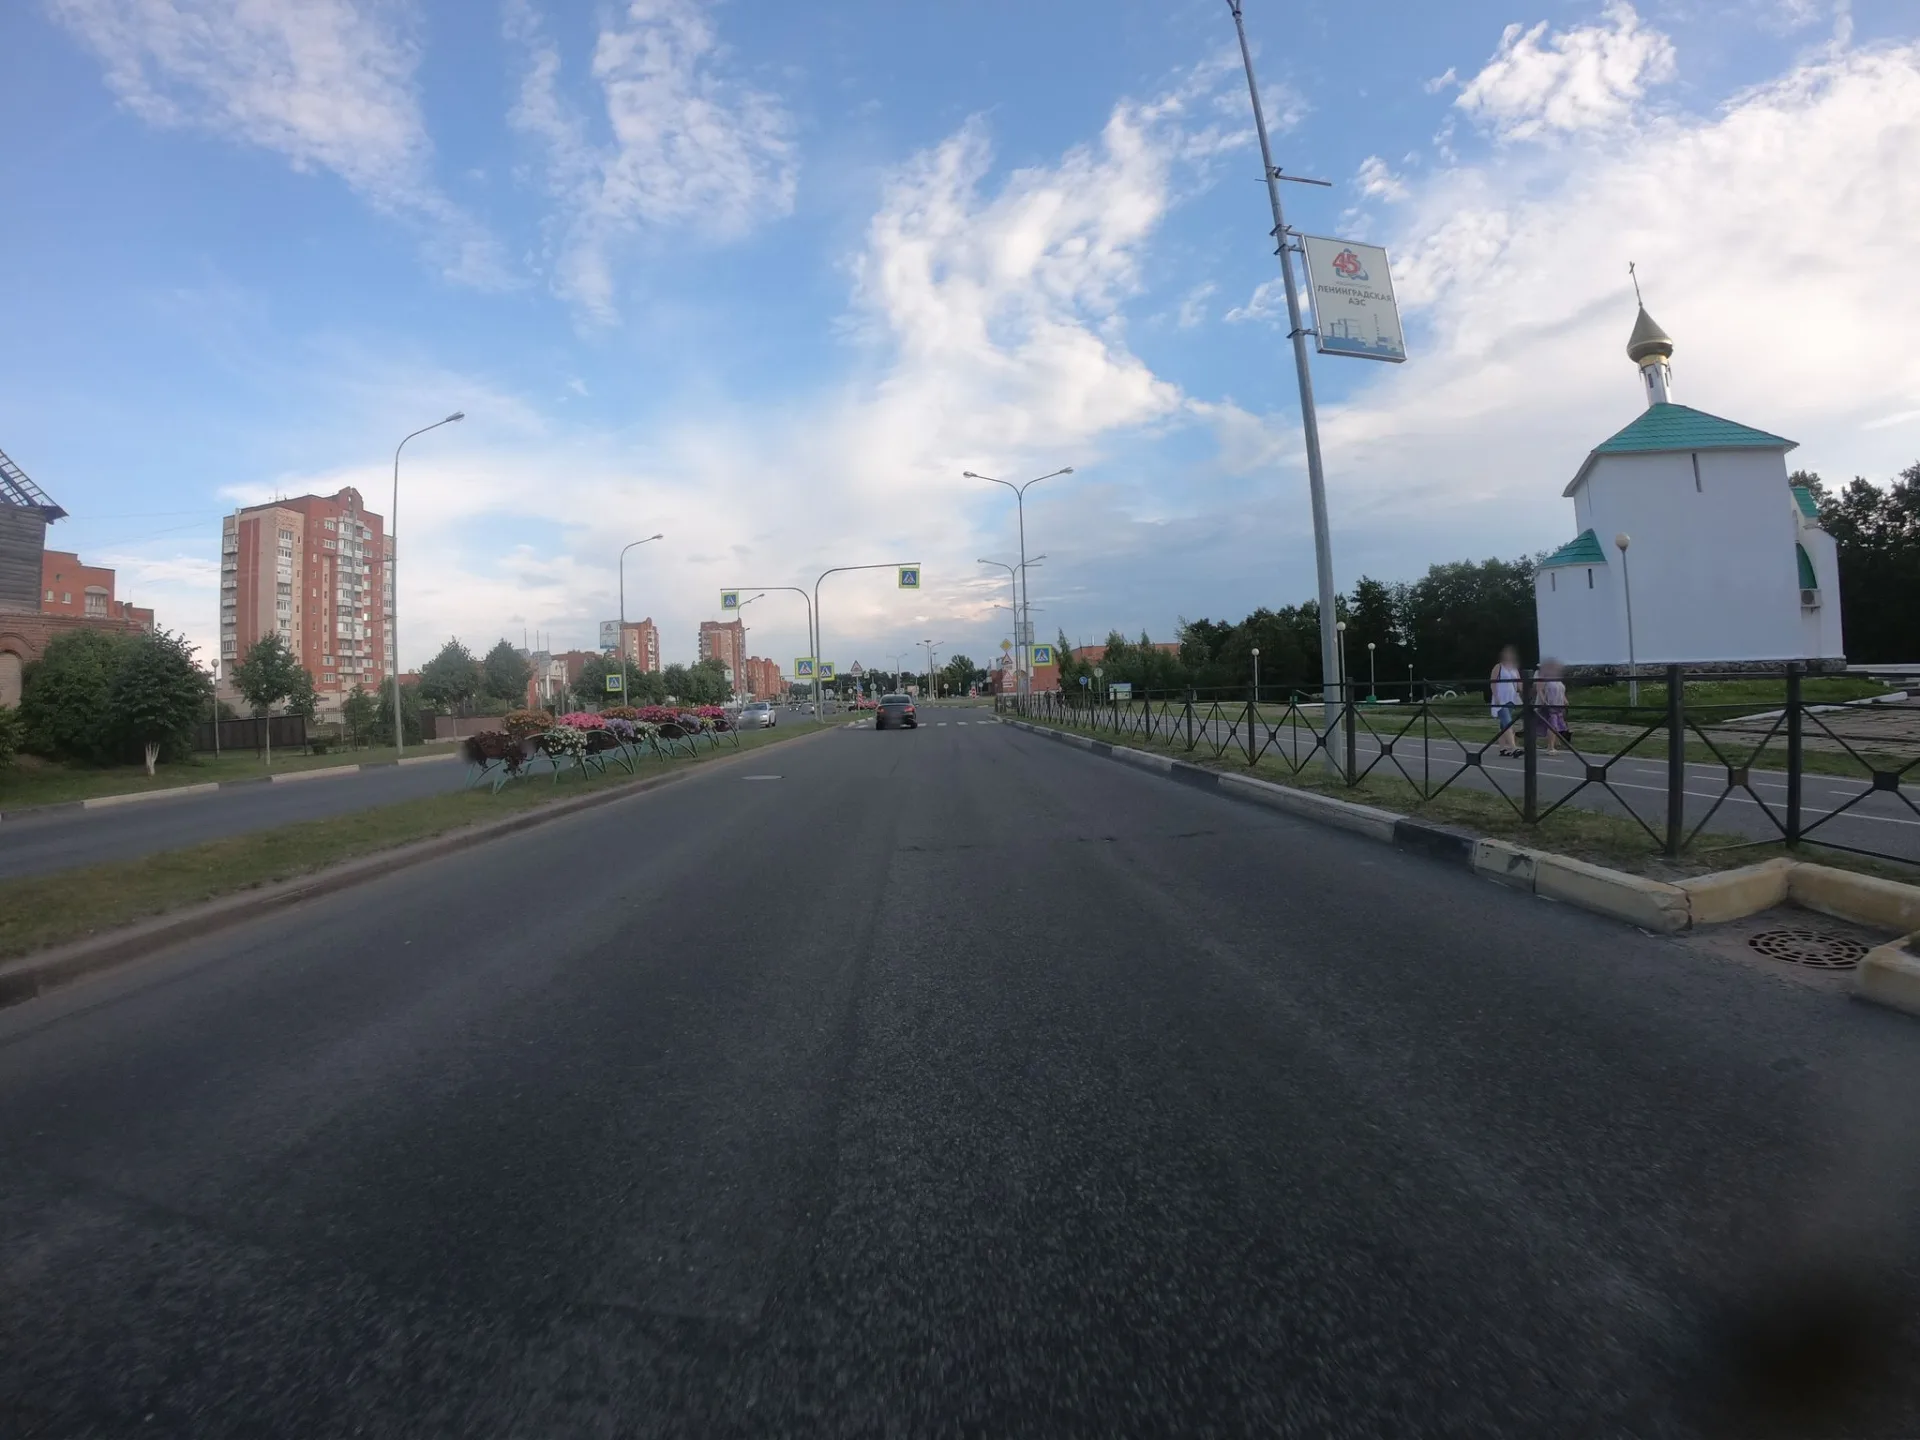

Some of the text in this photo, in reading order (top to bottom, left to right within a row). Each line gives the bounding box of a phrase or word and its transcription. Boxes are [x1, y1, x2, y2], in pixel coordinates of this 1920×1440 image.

[1332, 252, 1359, 274] 45
[1318, 285, 1392, 301] ЛЕНИНГРАДСКАЯ
[1348, 298, 1366, 306] АЭС
